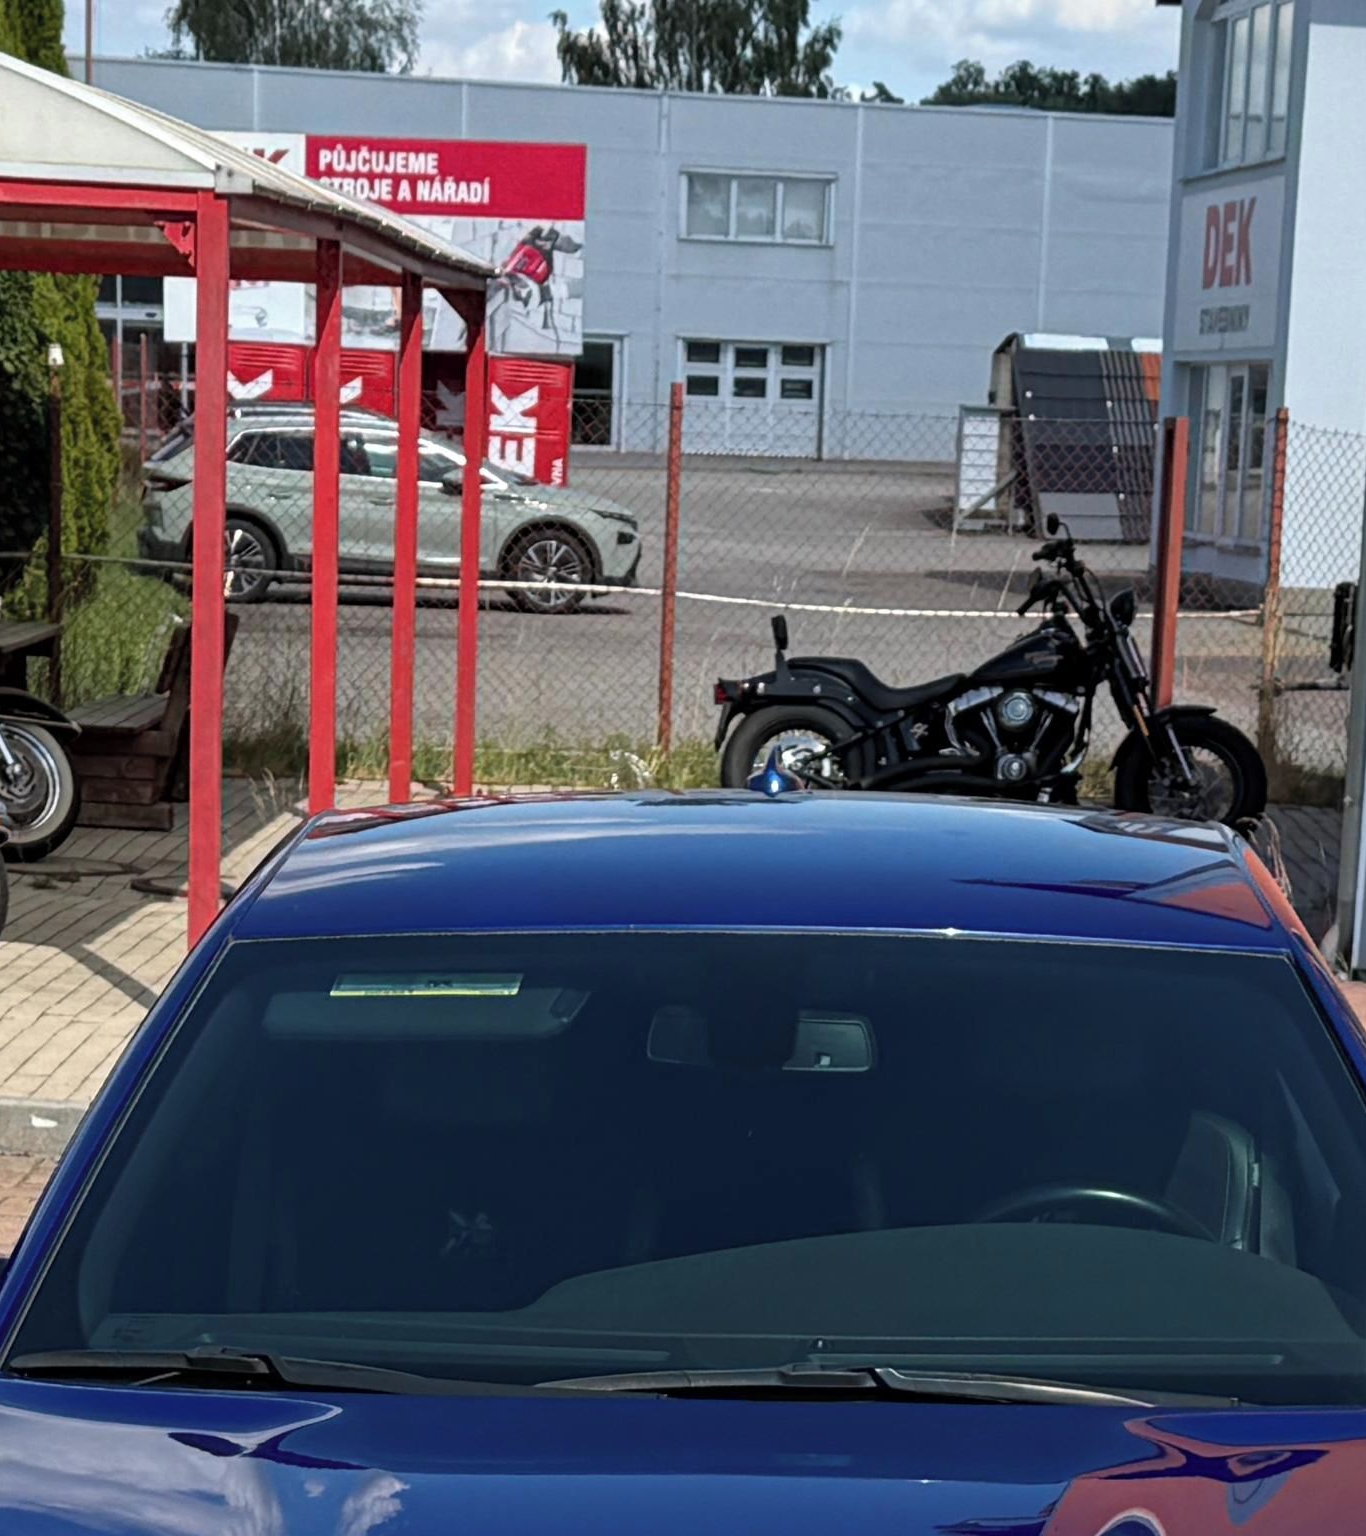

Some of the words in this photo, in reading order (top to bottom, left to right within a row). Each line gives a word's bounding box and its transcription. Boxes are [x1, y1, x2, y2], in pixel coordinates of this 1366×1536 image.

[319, 144, 439, 174] PŮJČUJEME
[397, 179, 411, 202] A
[416, 175, 491, 204] NÁŘADÍ
[1203, 196, 1257, 291] DEK
